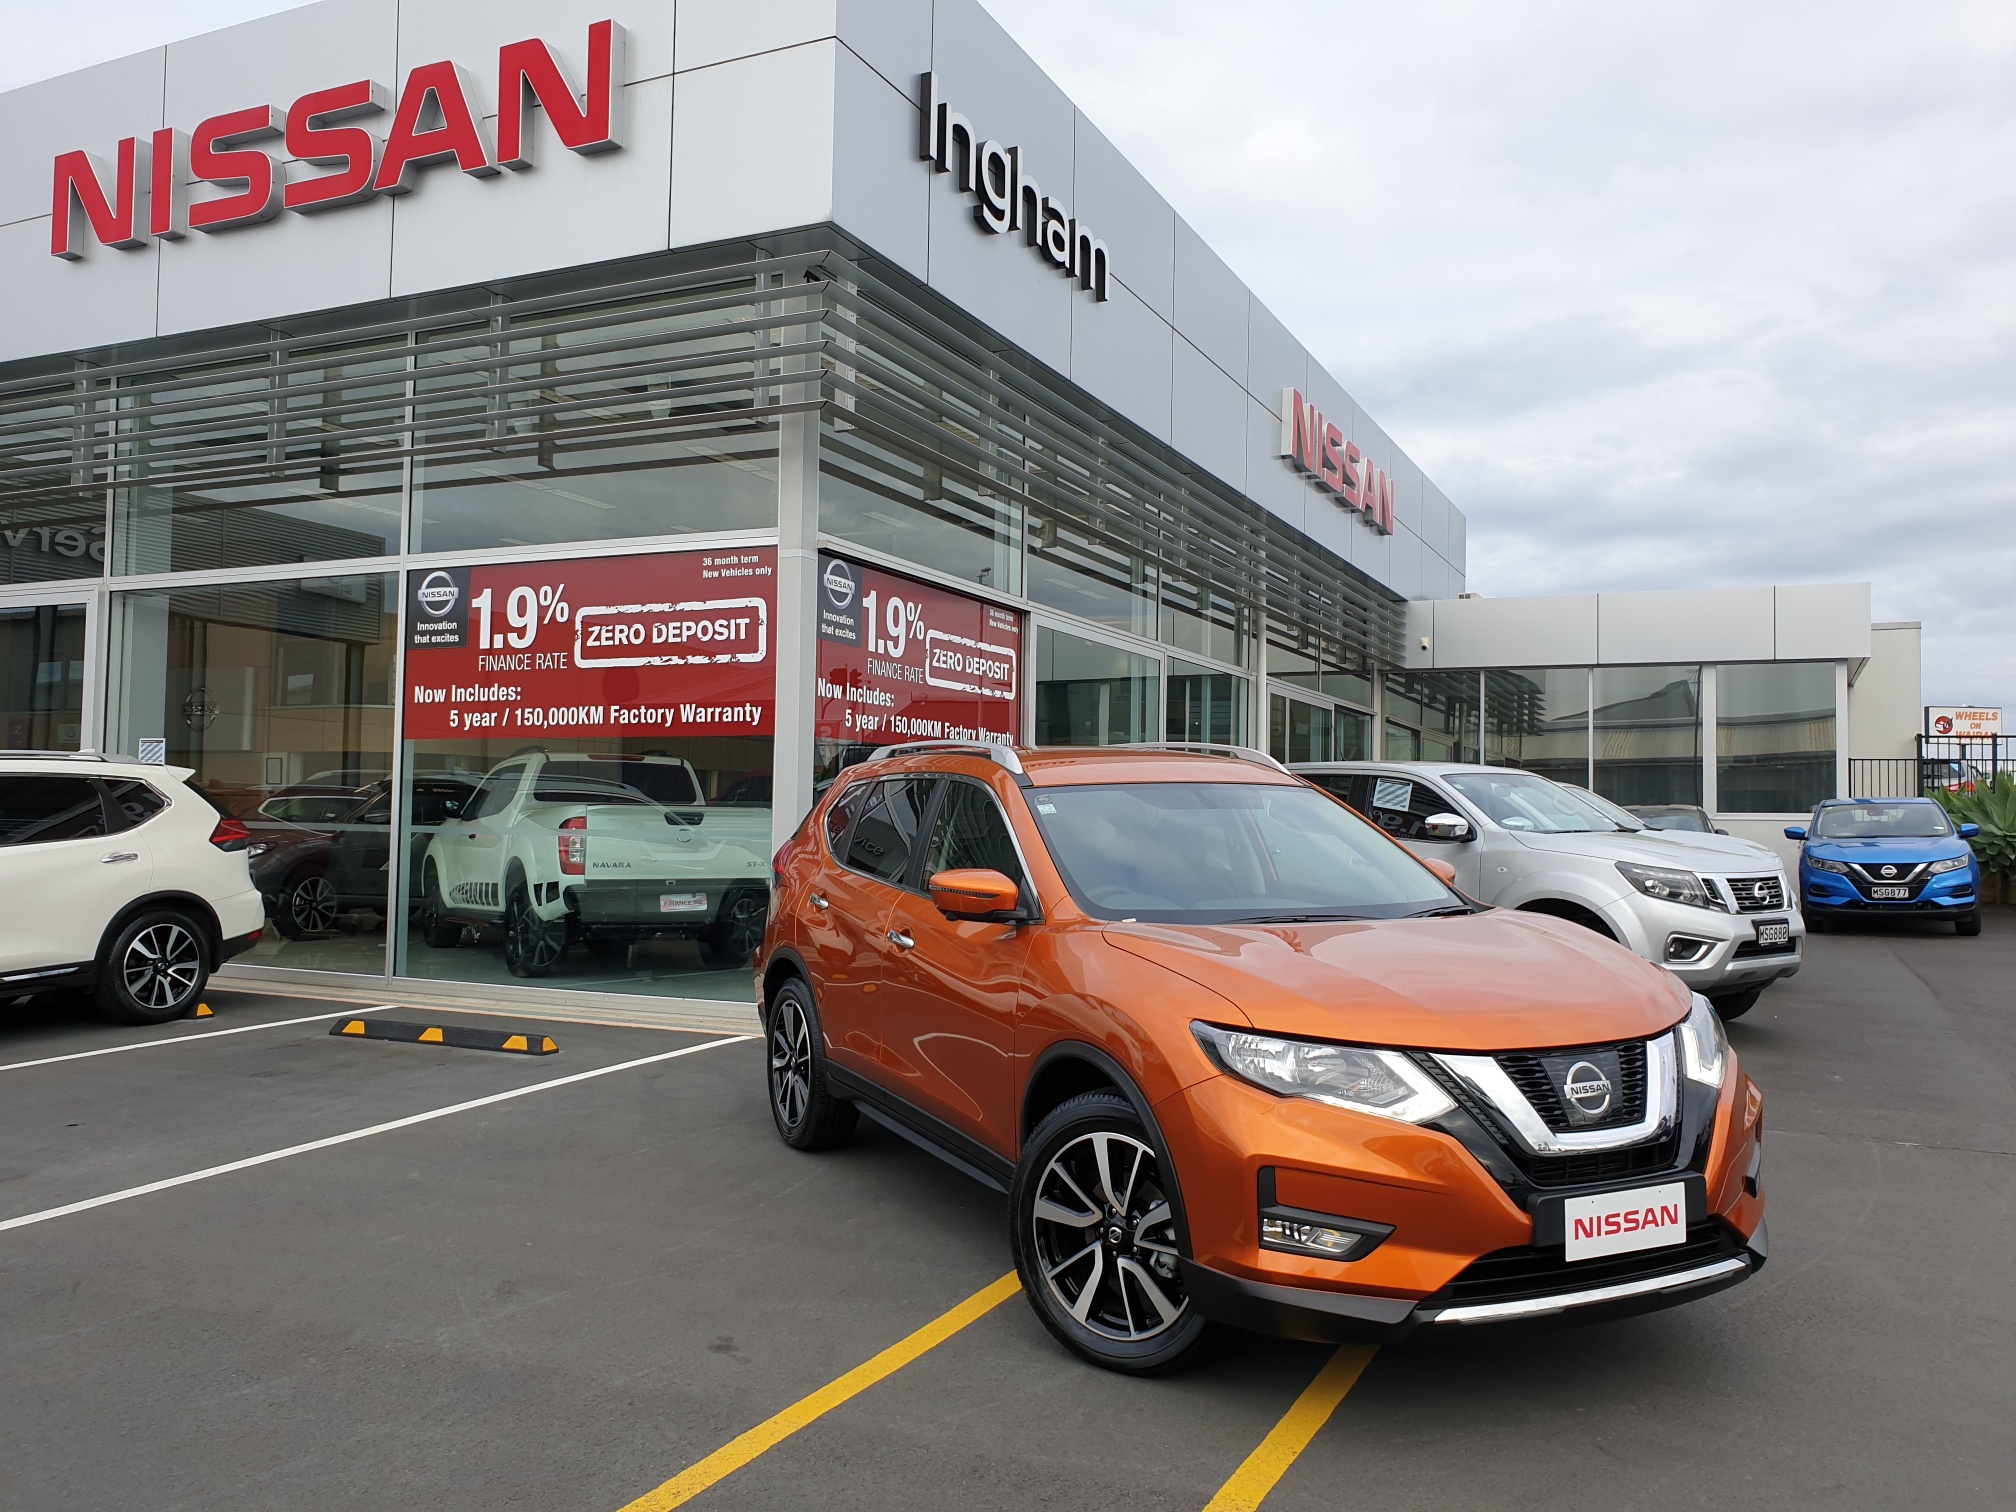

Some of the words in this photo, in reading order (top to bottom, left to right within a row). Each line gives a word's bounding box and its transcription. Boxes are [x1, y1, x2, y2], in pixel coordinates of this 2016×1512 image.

[51, 19, 620, 258] NISSAN
[920, 71, 1110, 302] Ingham
[1282, 387, 1394, 535] NISSAN
[703, 557, 712, 566] 36
[714, 555, 738, 565] month
[741, 555, 759, 563] term
[703, 569, 719, 578] New
[721, 567, 753, 577] Vehicles
[755, 566, 772, 576] only
[826, 577, 852, 591] NISSAN
[422, 590, 455, 598] NISSAN
[472, 583, 569, 649] 1.9%
[823, 609, 854, 626] Innovation
[862, 590, 925, 658] 1.9%
[417, 621, 457, 631] Innovation
[586, 623, 646, 646] ZERO
[652, 618, 750, 644] DEPOSIT
[822, 623, 834, 635] that
[835, 625, 856, 640] excites
[414, 634, 430, 643] that
[431, 633, 459, 643] excites
[479, 654, 532, 671] FINANCE
[536, 652, 568, 670] RATE
[867, 658, 902, 680] FINANCE
[904, 666, 924, 684] RATE
[932, 648, 963, 672] ZERO
[966, 656, 1009, 681] DEPOSIT
[414, 685, 446, 703] Now
[451, 683, 522, 702] Includes:
[817, 678, 842, 700] Now
[846, 682, 895, 707] Includes:
[450, 710, 459, 727] 5
[464, 711, 498, 730] year
[502, 707, 510, 727] /
[515, 705, 604, 729] 150,000KM
[610, 705, 675, 727] Factory
[680, 703, 762, 726] Warranty
[1955, 711, 1998, 721] WHEELS
[845, 709, 852, 727] 5
[855, 713, 879, 732] year
[881, 713, 887, 731] /
[890, 715, 941, 738] 150,000KM
[944, 722, 976, 741] Factory
[978, 726, 1014, 746] Warranty
[1955, 730, 1997, 741] WAIRA
[1872, 887, 1907, 898] MSG877
[1570, 1082, 1611, 1096] NISSAN
[1574, 1204, 1678, 1240] NISSAN
